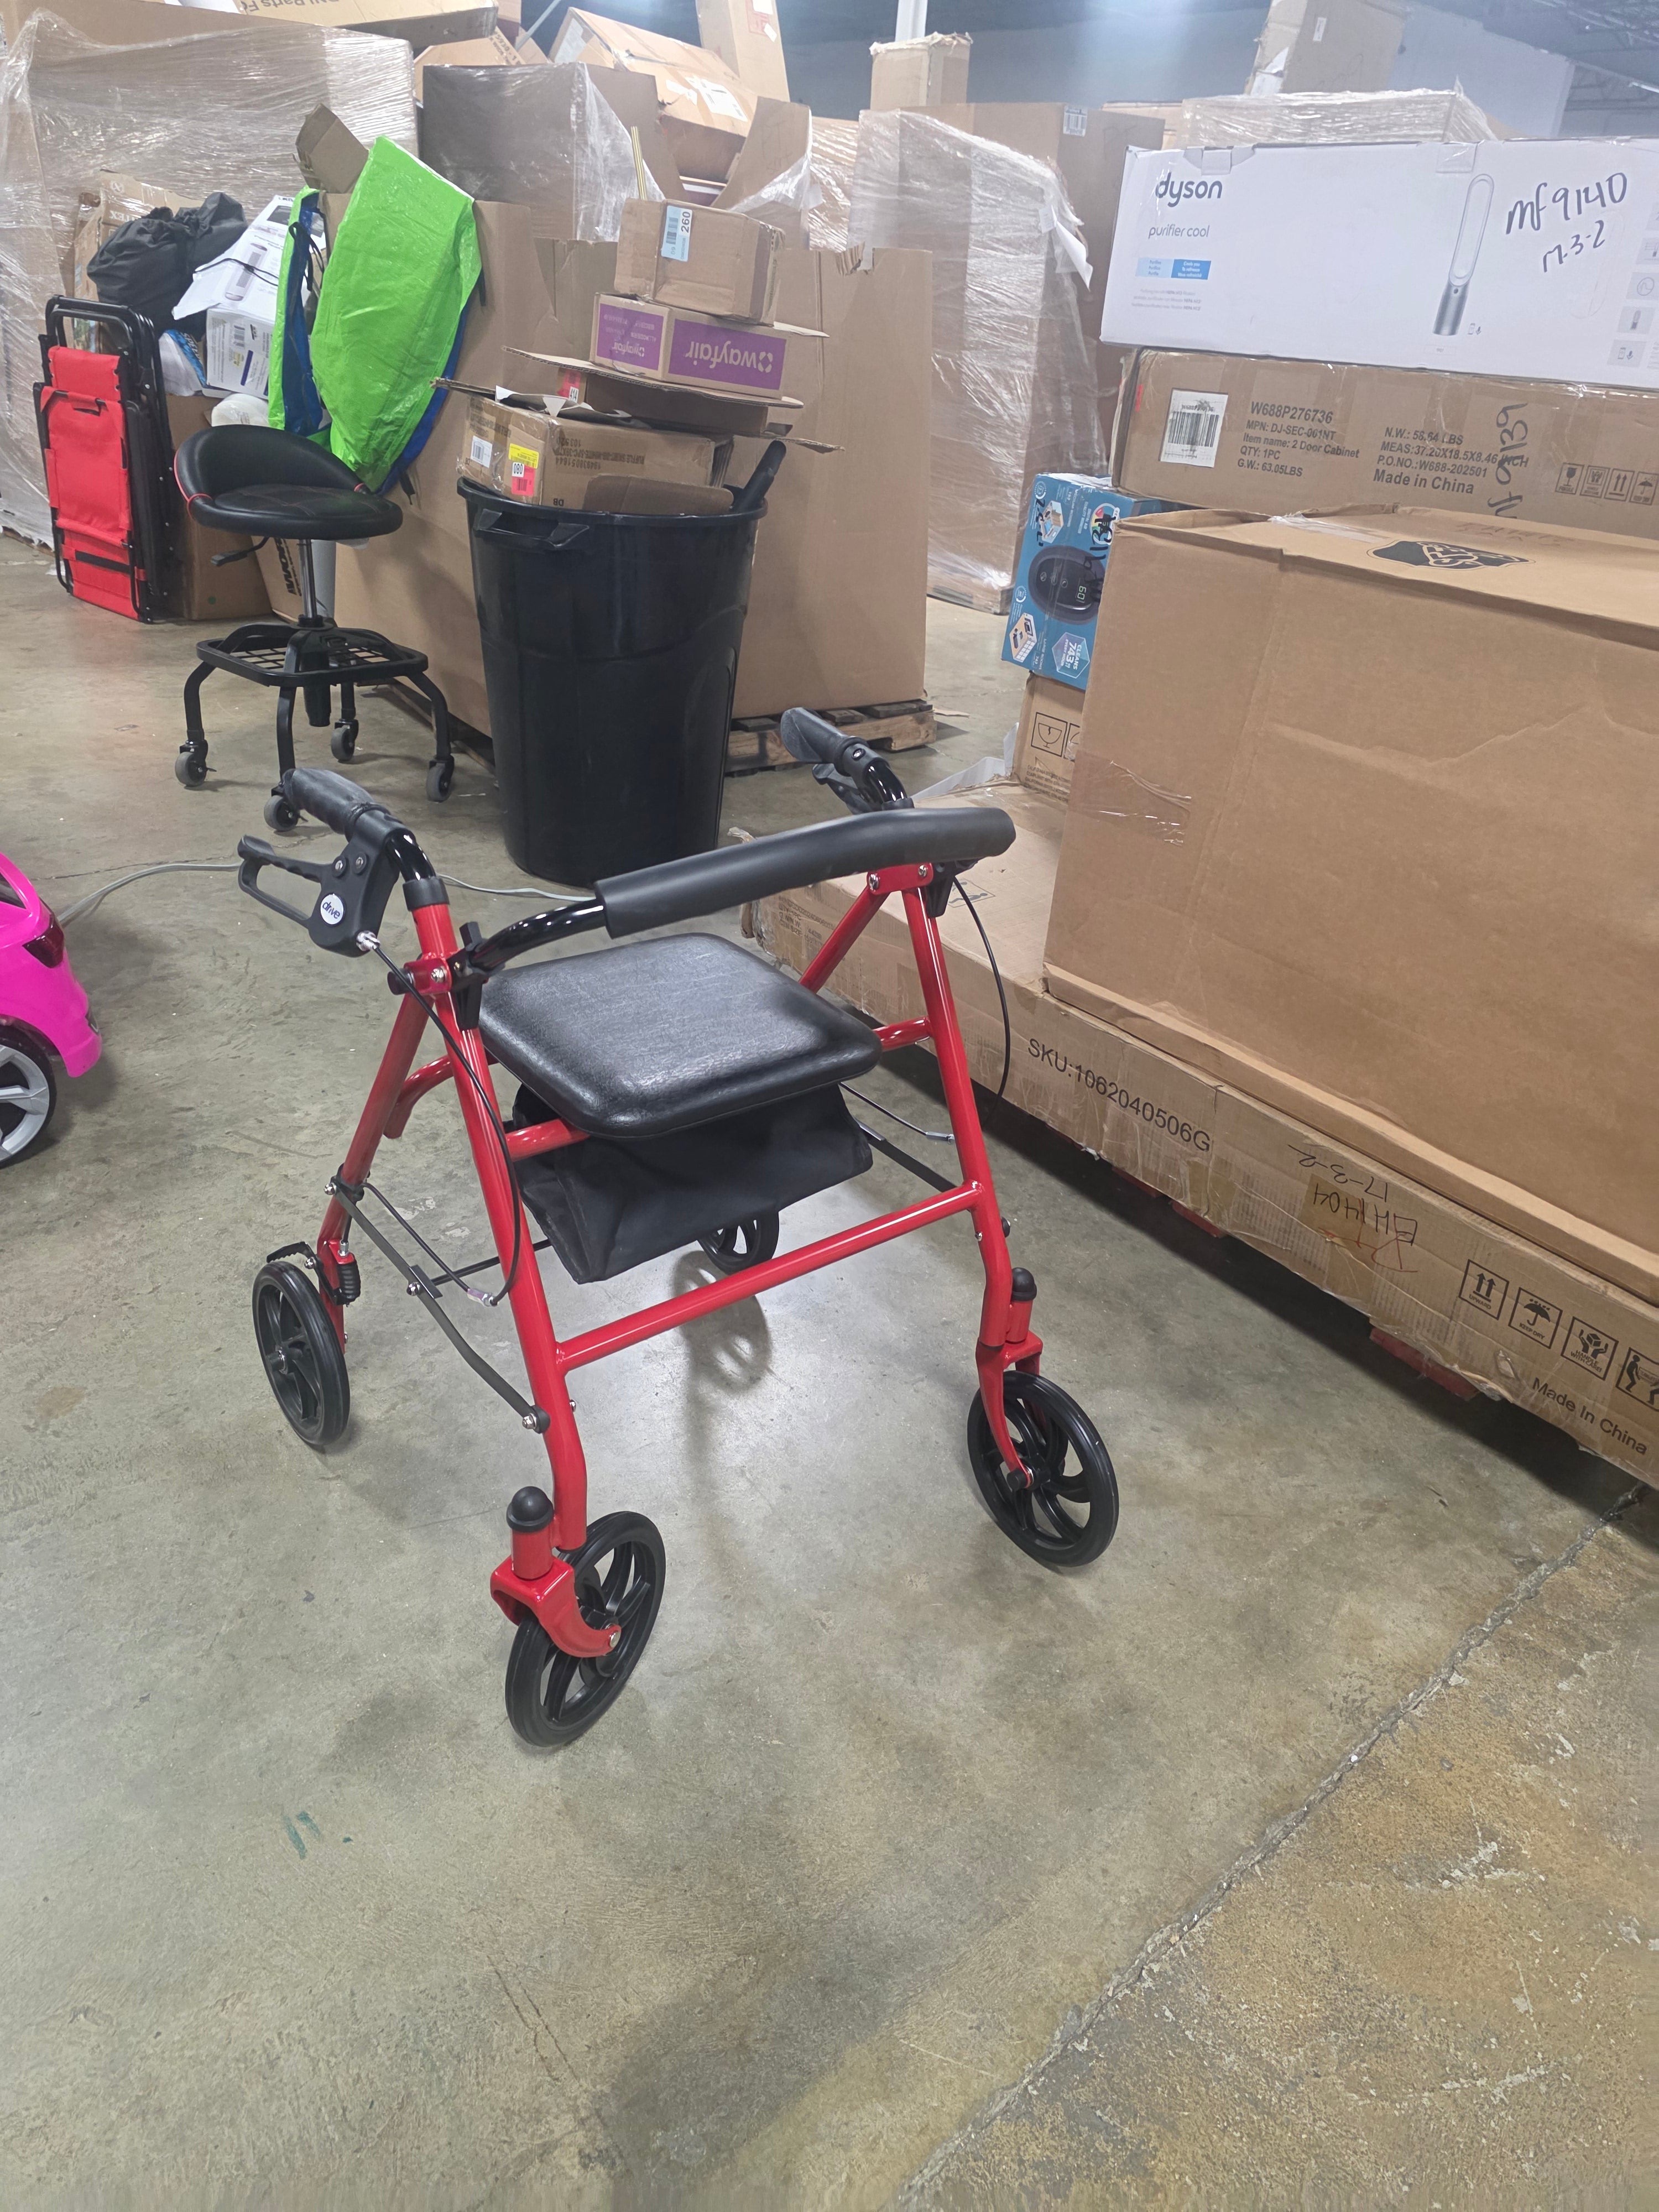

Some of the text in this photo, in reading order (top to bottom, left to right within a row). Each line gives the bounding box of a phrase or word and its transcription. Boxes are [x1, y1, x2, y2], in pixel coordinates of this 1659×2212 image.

[1155, 172, 1223, 207] dyson
[681, 211, 691, 233] 260
[1148, 224, 1210, 239] purifier cool
[612, 341, 640, 356] wayfair
[685, 341, 757, 369] wayfair
[1250, 401, 1333, 424] W688P276736
[1246, 419, 1268, 431] MPN:
[1385, 427, 1410, 439] N.W.:
[1240, 445, 1281, 460] QTY: 1PC
[1243, 432, 1359, 458] Item name: 2 Door Cabinet
[1238, 458, 1303, 477] G.W.: 63.05LBS
[1374, 468, 1474, 494] Made in China
[553, 498, 564, 507] DB
[1066, 641, 1077, 664] 743
[1073, 645, 1082, 670] CLEANS
[322, 901, 340, 919] drive
[1028, 1038, 1211, 1152] SKU:1062040506G
[1469, 1293, 1492, 1310] UPWARD
[1519, 1322, 1545, 1340] KEEP DRY
[1575, 1350, 1599, 1366] HANDLE
[1532, 1377, 1647, 1455] Made In China
